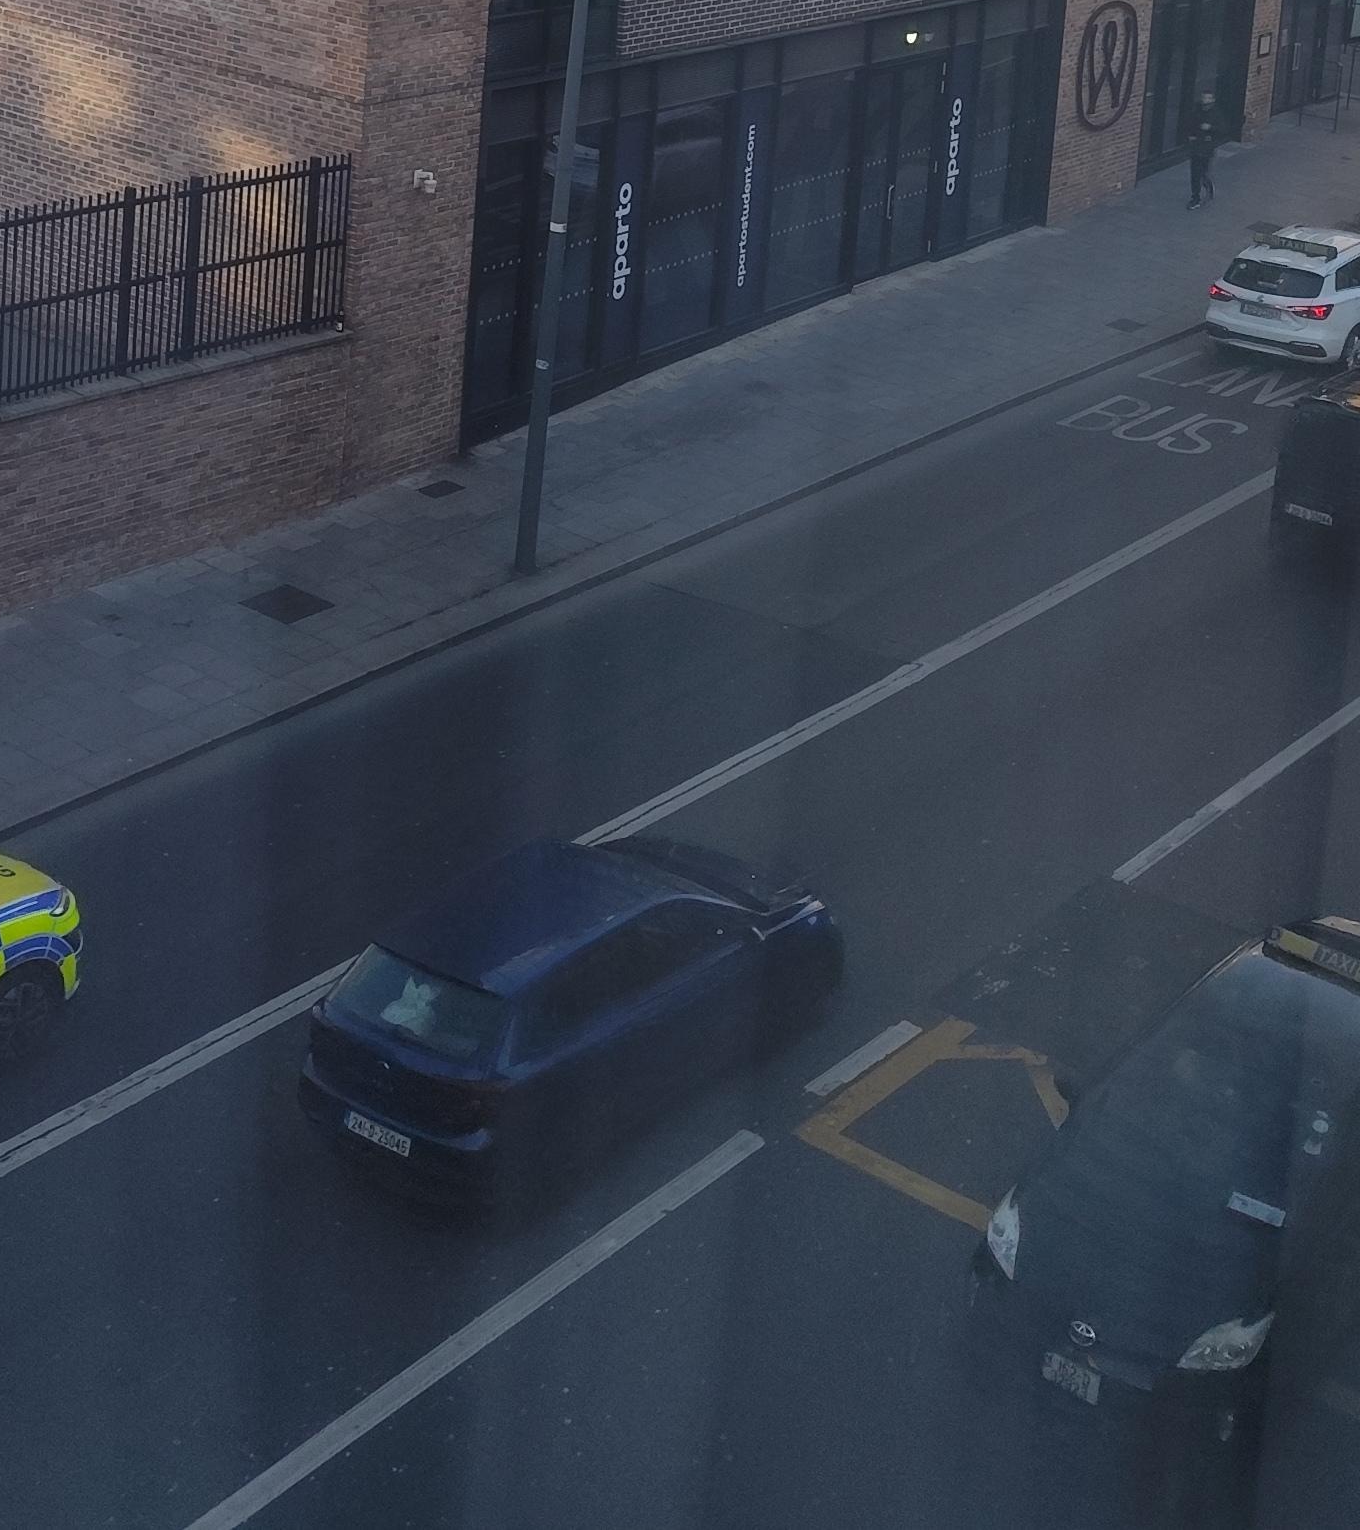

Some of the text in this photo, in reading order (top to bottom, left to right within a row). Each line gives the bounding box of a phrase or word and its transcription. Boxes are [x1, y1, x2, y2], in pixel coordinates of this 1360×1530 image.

[945, 97, 963, 196] aparto
[612, 182, 633, 300] aparto
[736, 123, 757, 287] apartostudent.com
[1056, 395, 1249, 454] BUS
[1317, 945, 1359, 977] TAXI
